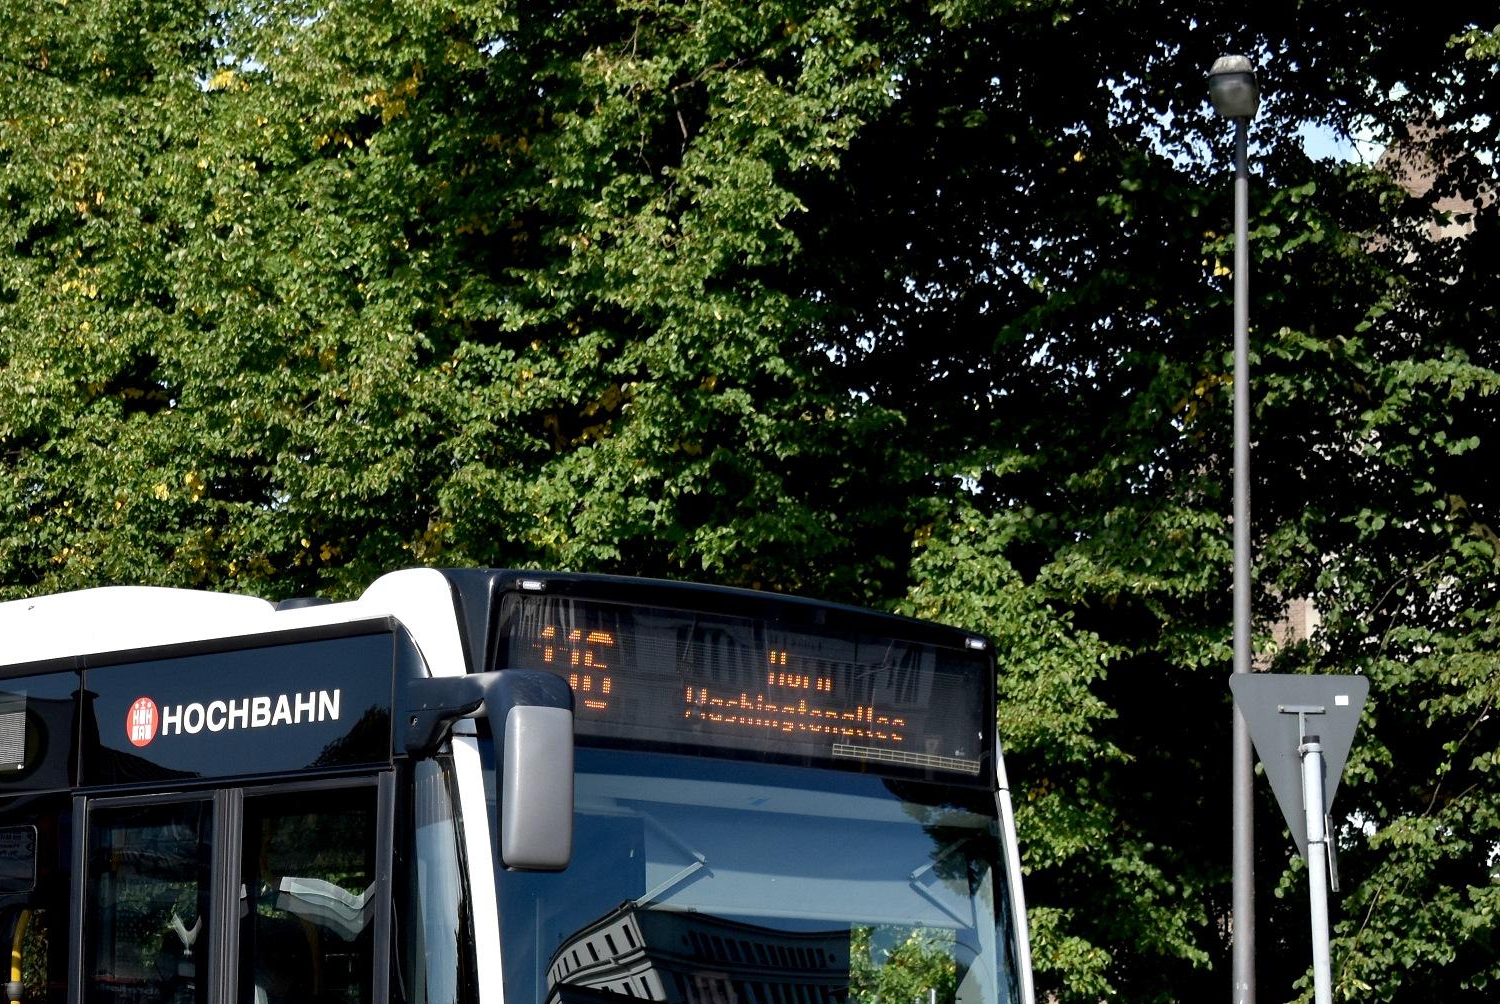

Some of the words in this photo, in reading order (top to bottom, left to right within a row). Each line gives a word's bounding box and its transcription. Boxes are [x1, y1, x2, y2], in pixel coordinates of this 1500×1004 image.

[768, 650, 832, 692] Horn
[161, 689, 341, 736] HOCHBAHN
[684, 687, 905, 742] Washingtonallee
